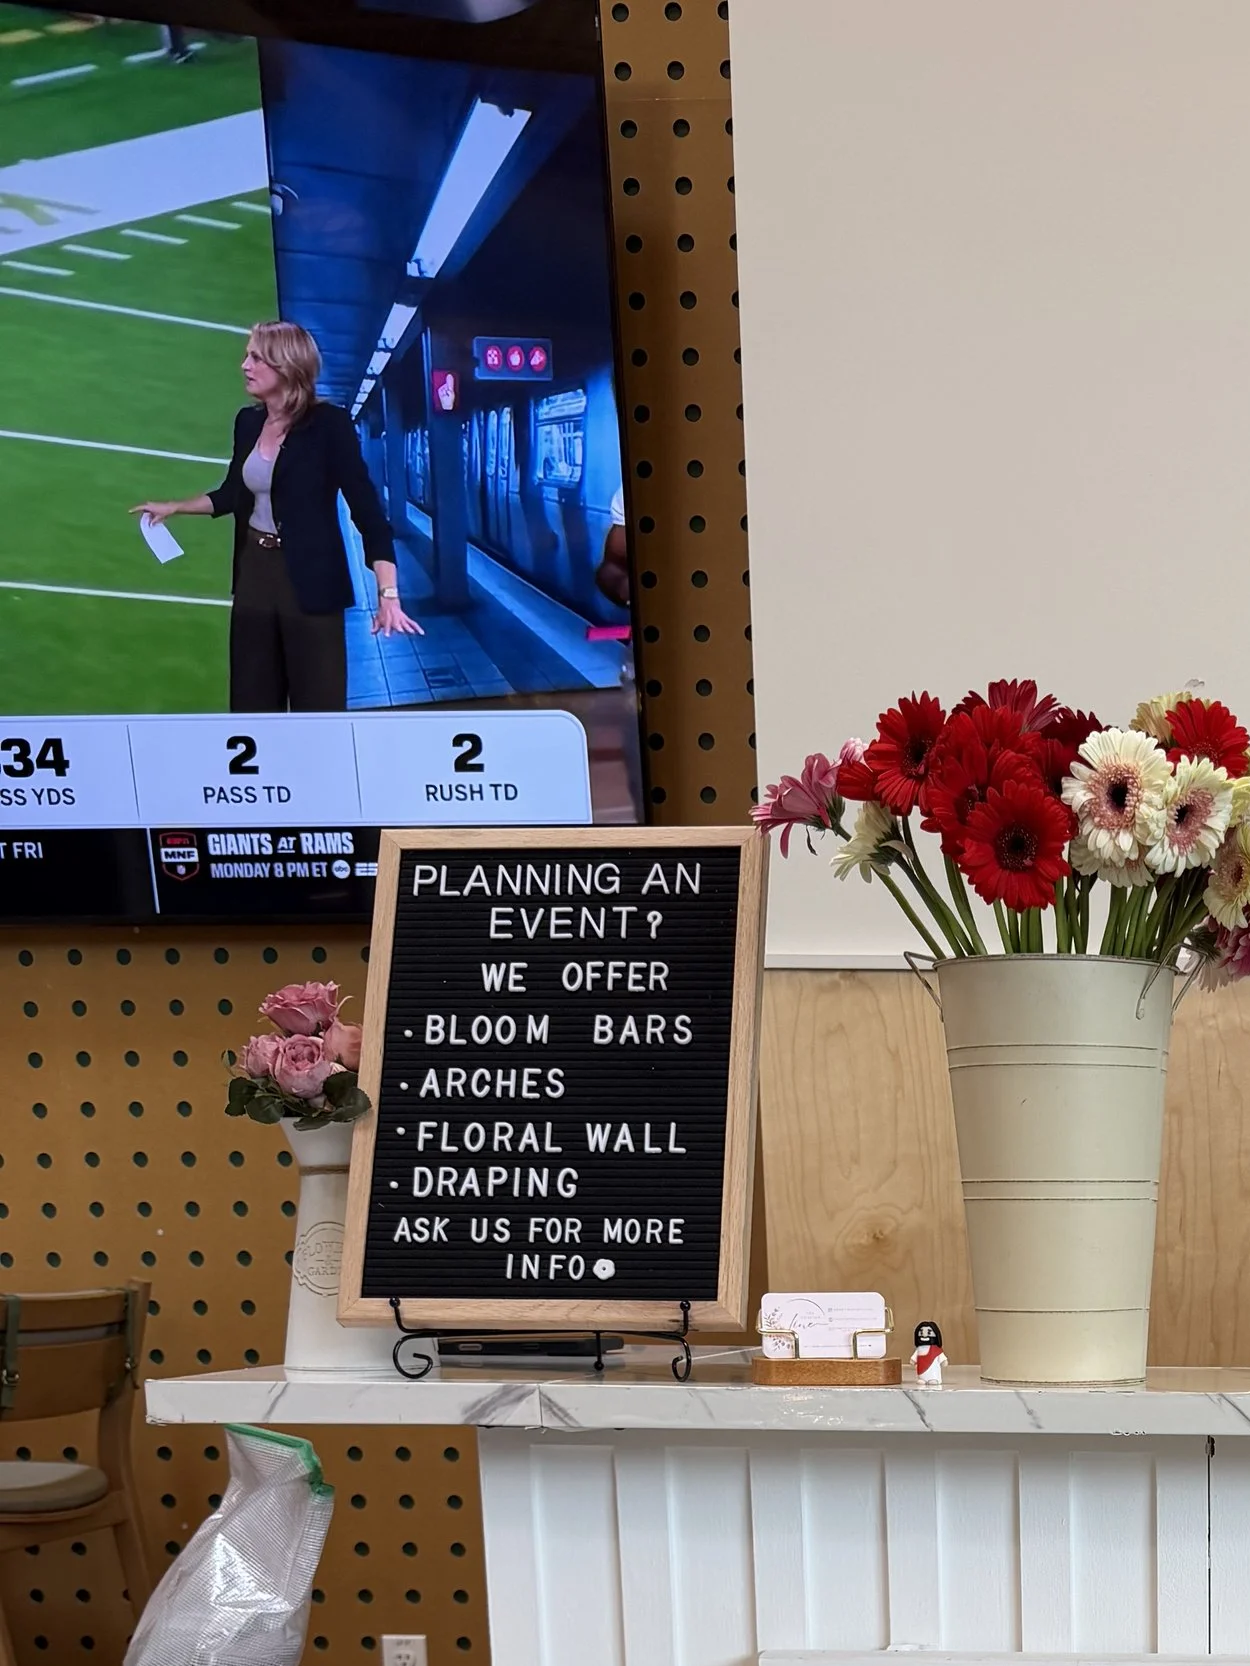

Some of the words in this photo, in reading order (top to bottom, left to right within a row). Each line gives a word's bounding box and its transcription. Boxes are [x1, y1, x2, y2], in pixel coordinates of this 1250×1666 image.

[227, 736, 259, 774] 2
[452, 734, 484, 772] 2
[31, 788, 75, 805] YDS
[203, 786, 257, 803] PASS
[263, 786, 290, 803] TD
[426, 784, 483, 801] RUSH
[490, 784, 517, 800] TD
[13, 842, 43, 858] FRI
[164, 851, 195, 860] MNF
[208, 833, 273, 855] GIANTS
[278, 837, 296, 853] AT
[300, 832, 354, 854] RAMS
[211, 863, 270, 878] MONDAY
[274, 863, 284, 877] 8
[287, 863, 309, 877] PM
[312, 862, 327, 877] ET
[414, 863, 619, 895] PLANNING
[642, 863, 700, 893] AN
[490, 907, 662, 938] EVENT?
[482, 963, 527, 991] WE
[563, 962, 668, 991] OFFER
[426, 1015, 548, 1044] BLOOM
[594, 1015, 691, 1044] BARS
[420, 1068, 564, 1098] ARCHES
[418, 1122, 562, 1152] FLORAL
[586, 1123, 686, 1153] WALL
[414, 1167, 578, 1197] DRAPING
[394, 1217, 449, 1242] ASK
[472, 1218, 510, 1242] US
[529, 1218, 581, 1242] FOR
[604, 1218, 684, 1243] MORE
[308, 1266, 341, 1276] GARD
[507, 1254, 584, 1279] INFO
